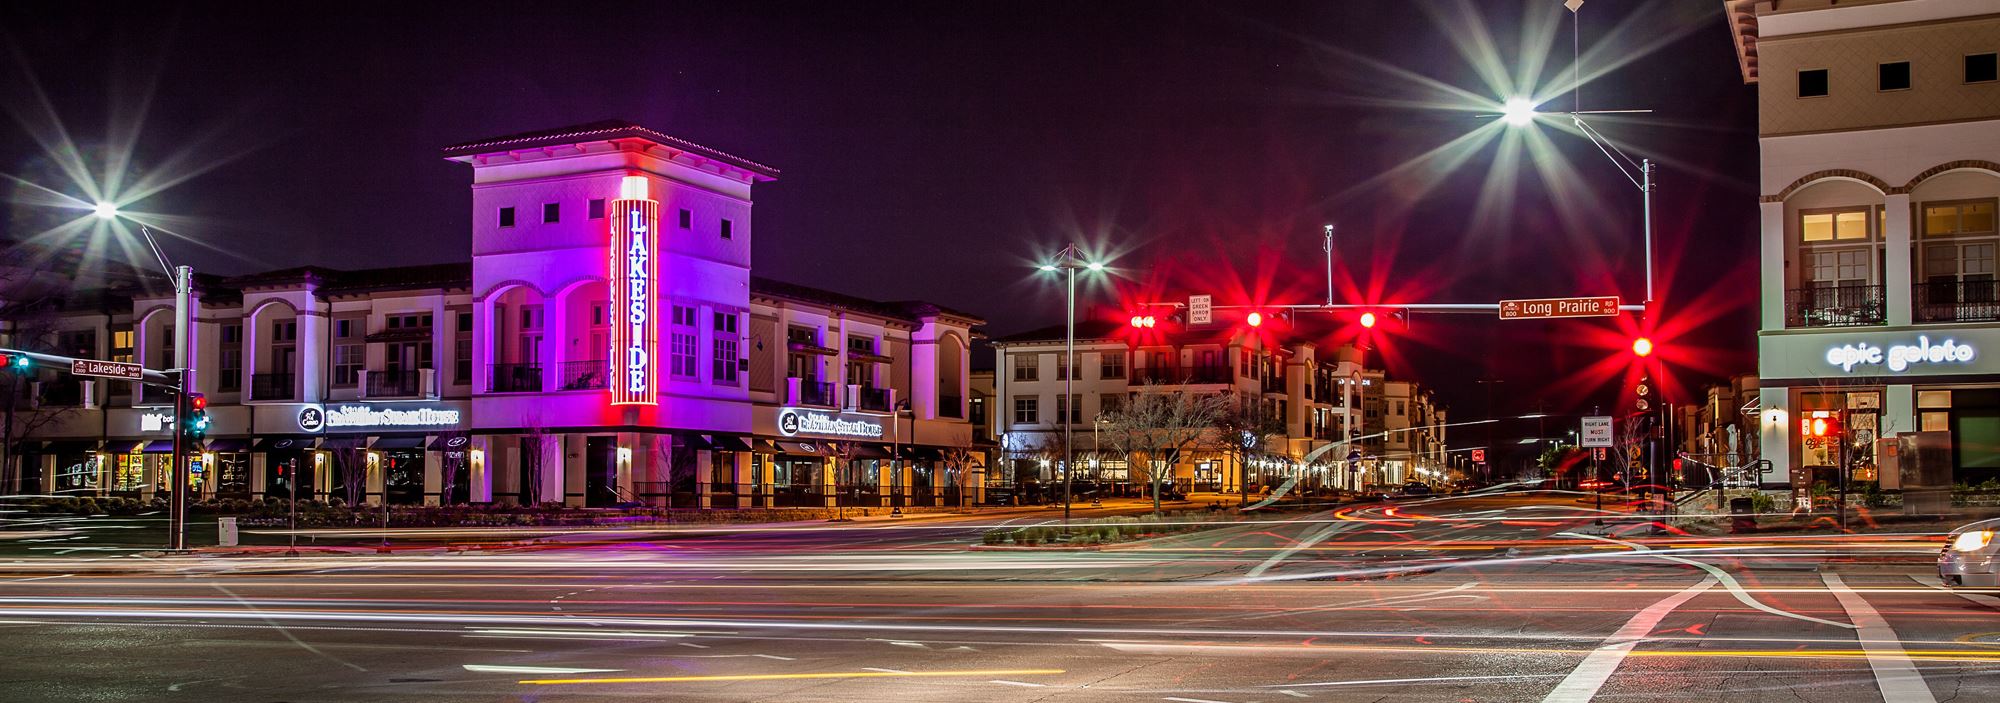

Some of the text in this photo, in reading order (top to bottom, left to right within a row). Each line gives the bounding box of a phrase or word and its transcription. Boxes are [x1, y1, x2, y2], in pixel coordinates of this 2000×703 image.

[629, 210, 647, 393] LAKESIDE
[1523, 299, 1600, 316] Long Prairie
[1827, 335, 1974, 372] epic gelato
[88, 362, 126, 375] Lakeside
